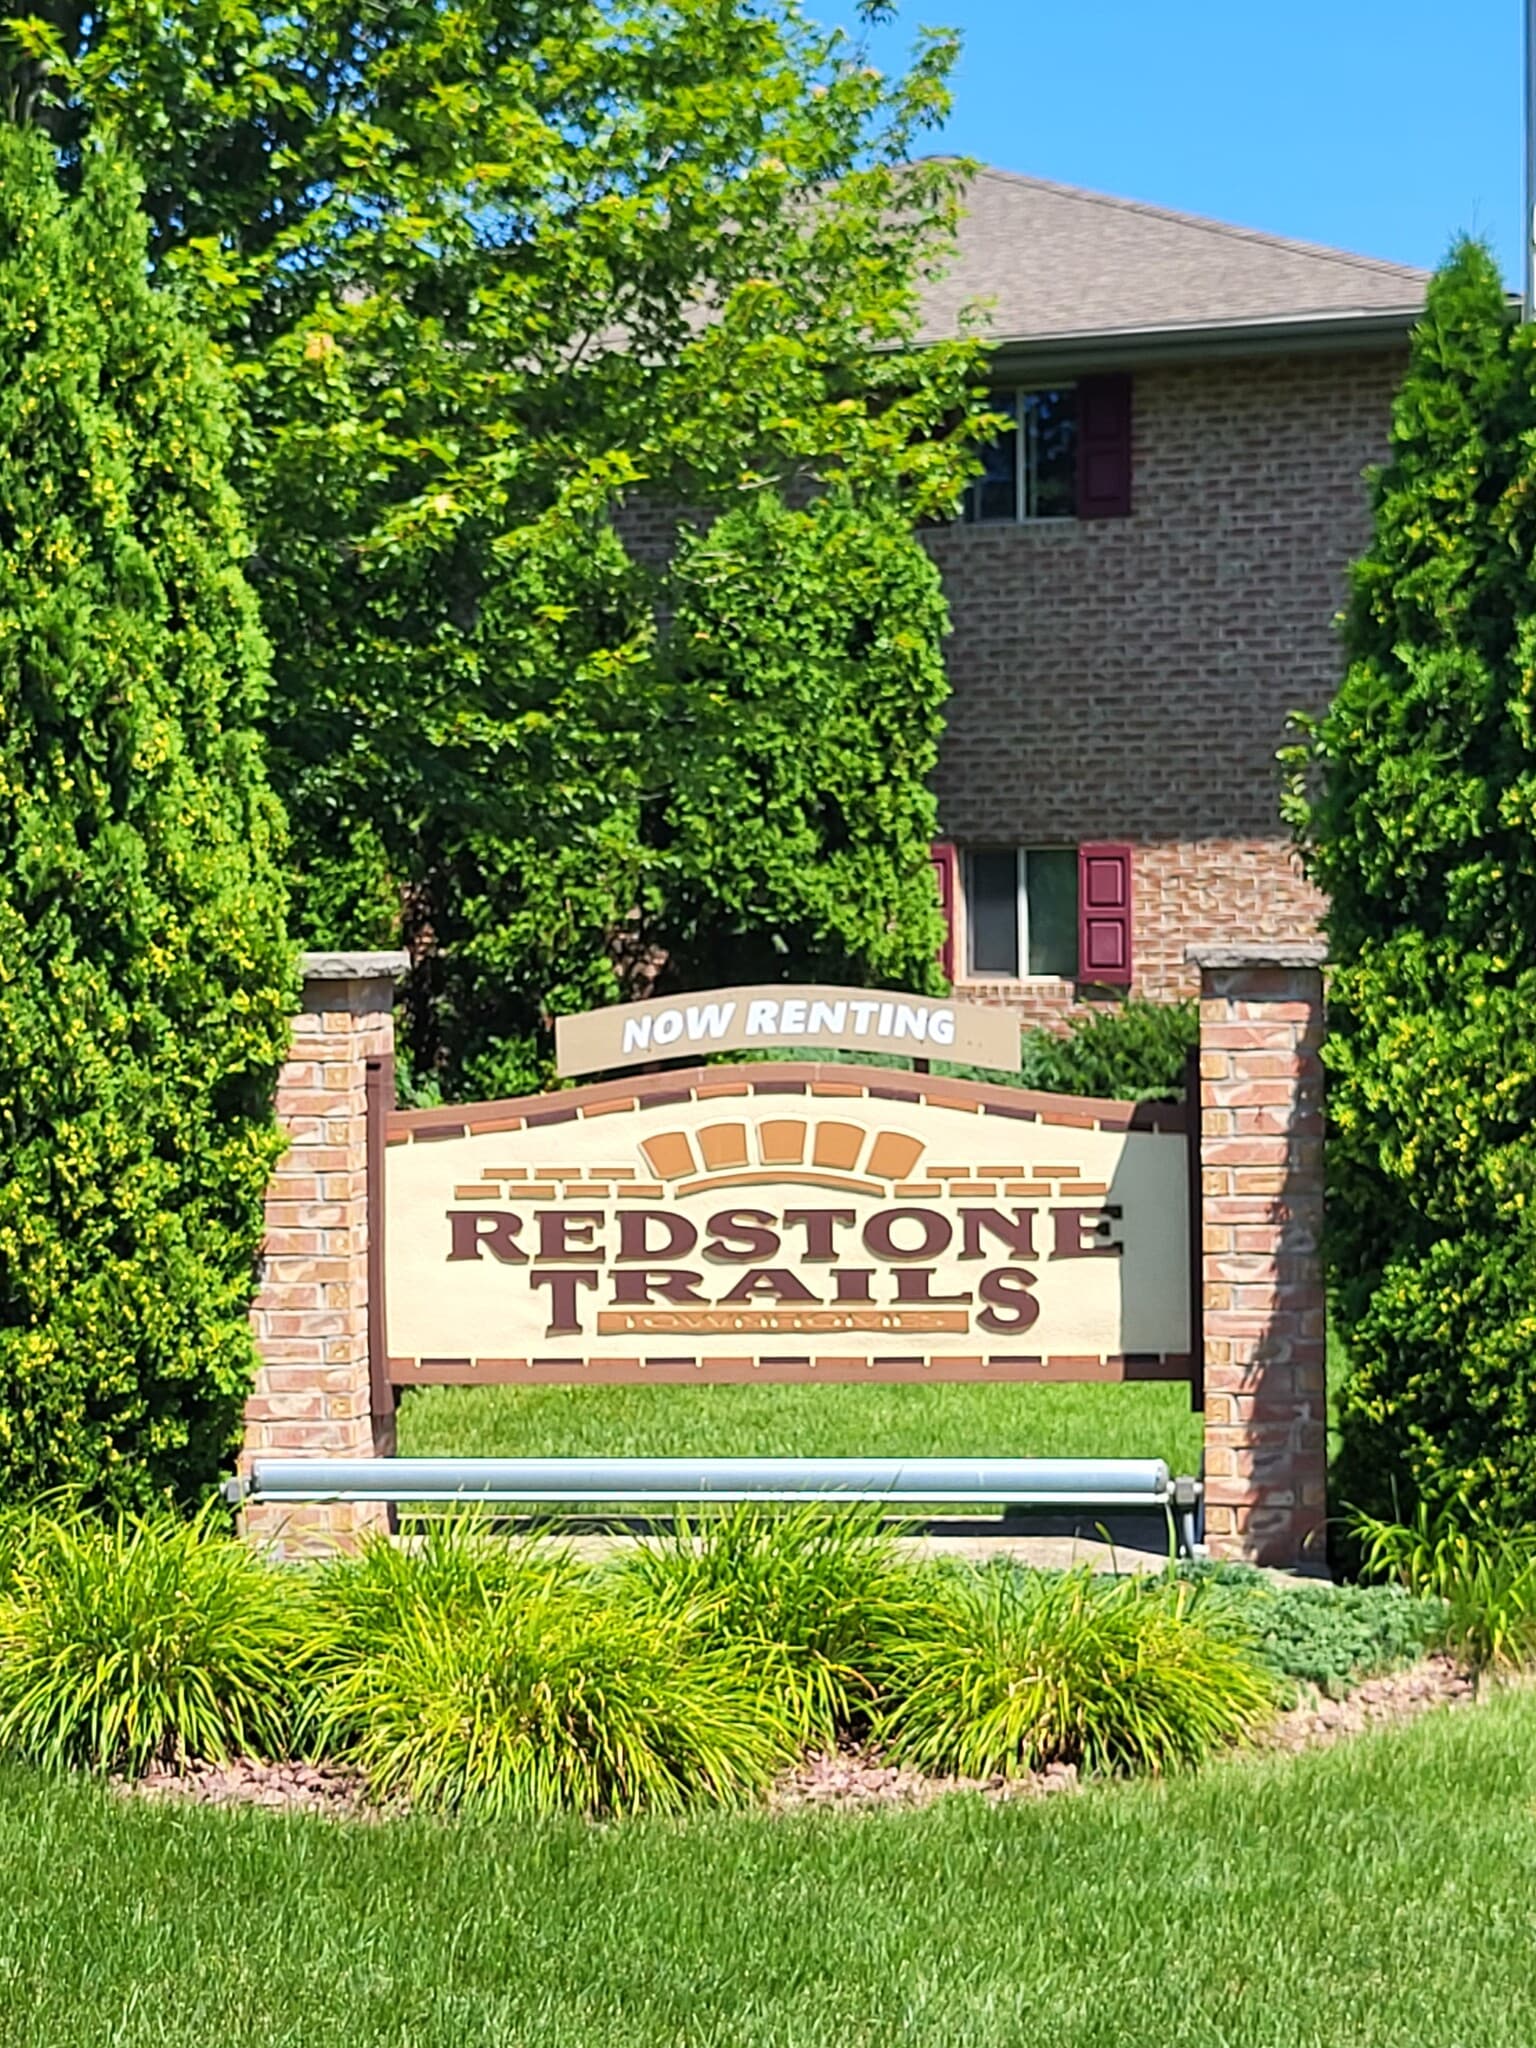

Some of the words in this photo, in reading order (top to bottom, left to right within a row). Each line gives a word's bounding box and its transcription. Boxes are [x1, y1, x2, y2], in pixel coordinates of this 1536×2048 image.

[622, 1001, 736, 1053] NOW
[745, 1000, 955, 1045] RENTING
[445, 1204, 1123, 1263] REDSTONE
[530, 1267, 1040, 1338] TRAILS
